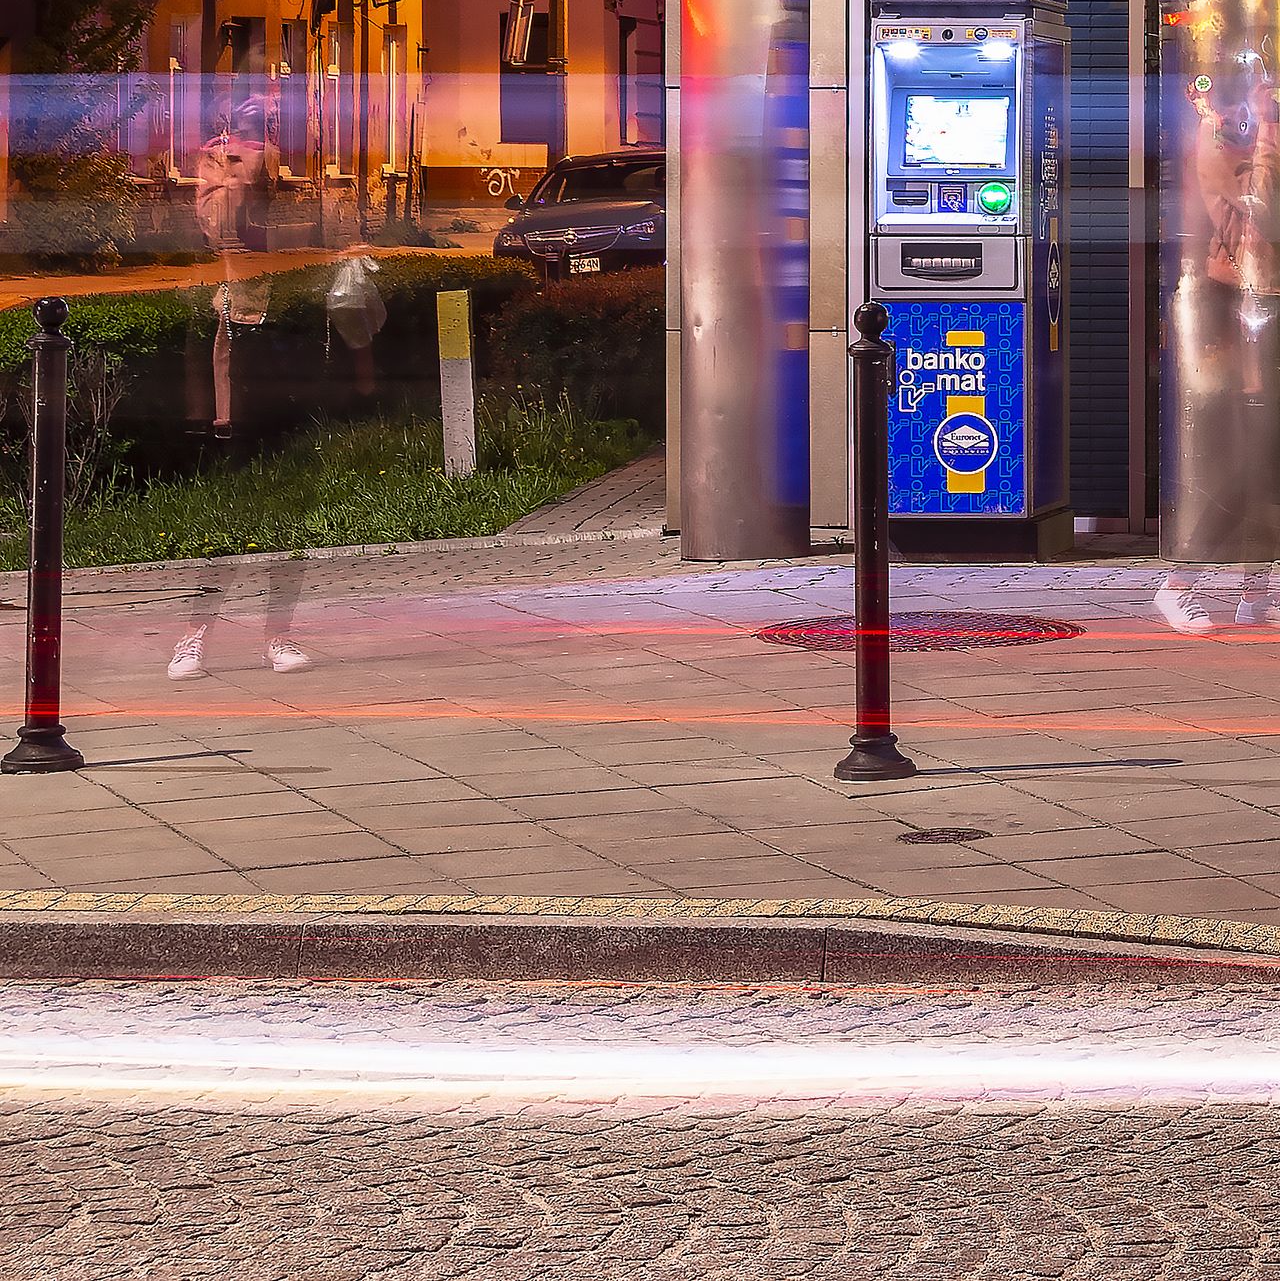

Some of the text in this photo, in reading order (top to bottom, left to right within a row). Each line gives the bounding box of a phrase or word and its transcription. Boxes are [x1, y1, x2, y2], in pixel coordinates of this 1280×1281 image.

[906, 348, 986, 370] banko
[936, 371, 986, 391] mat
[950, 433, 982, 441] Euronet
